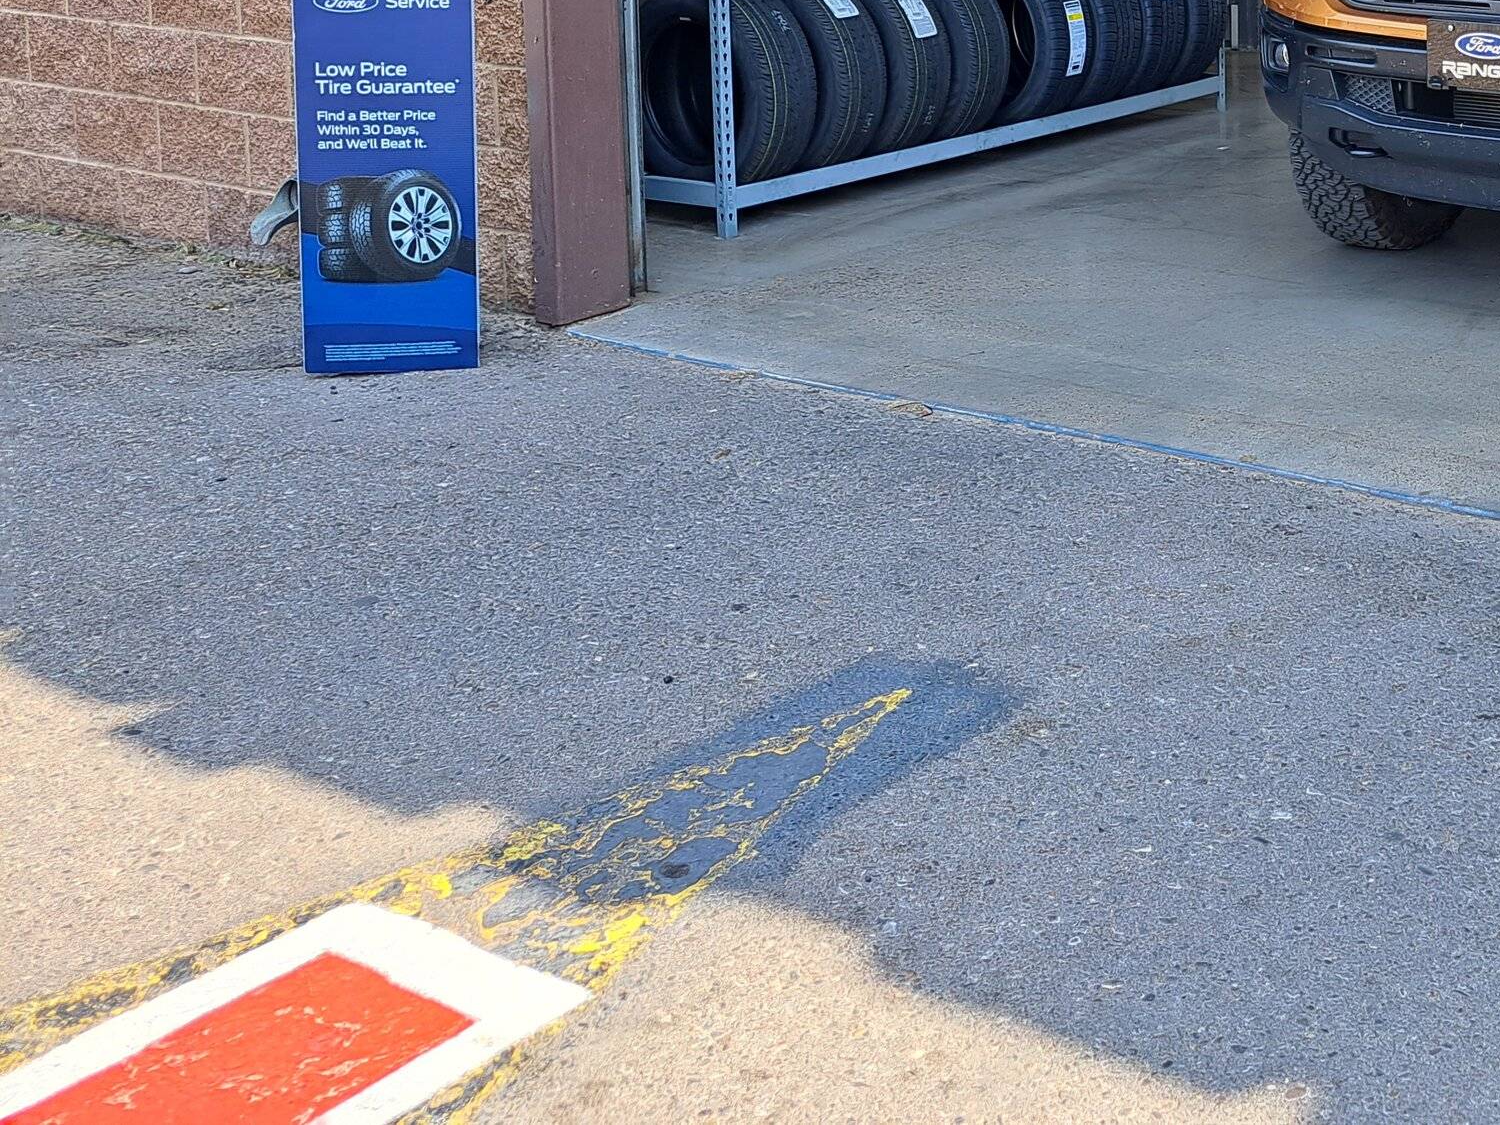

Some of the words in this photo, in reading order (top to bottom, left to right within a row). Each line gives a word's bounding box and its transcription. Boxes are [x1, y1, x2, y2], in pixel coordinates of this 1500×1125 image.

[315, 62, 355, 77] Low
[360, 62, 407, 77] Price
[315, 80, 351, 94] Tire
[317, 111, 344, 121] Find
[348, 113, 356, 121] a
[360, 111, 401, 121] Better
[404, 110, 436, 121] Price
[318, 125, 359, 135] Within
[363, 125, 380, 135] 30
[384, 125, 419, 137] Days,
[318, 139, 342, 149] and
[346, 139, 377, 149] We'll
[381, 139, 411, 149] Beat
[414, 138, 427, 149] It.
